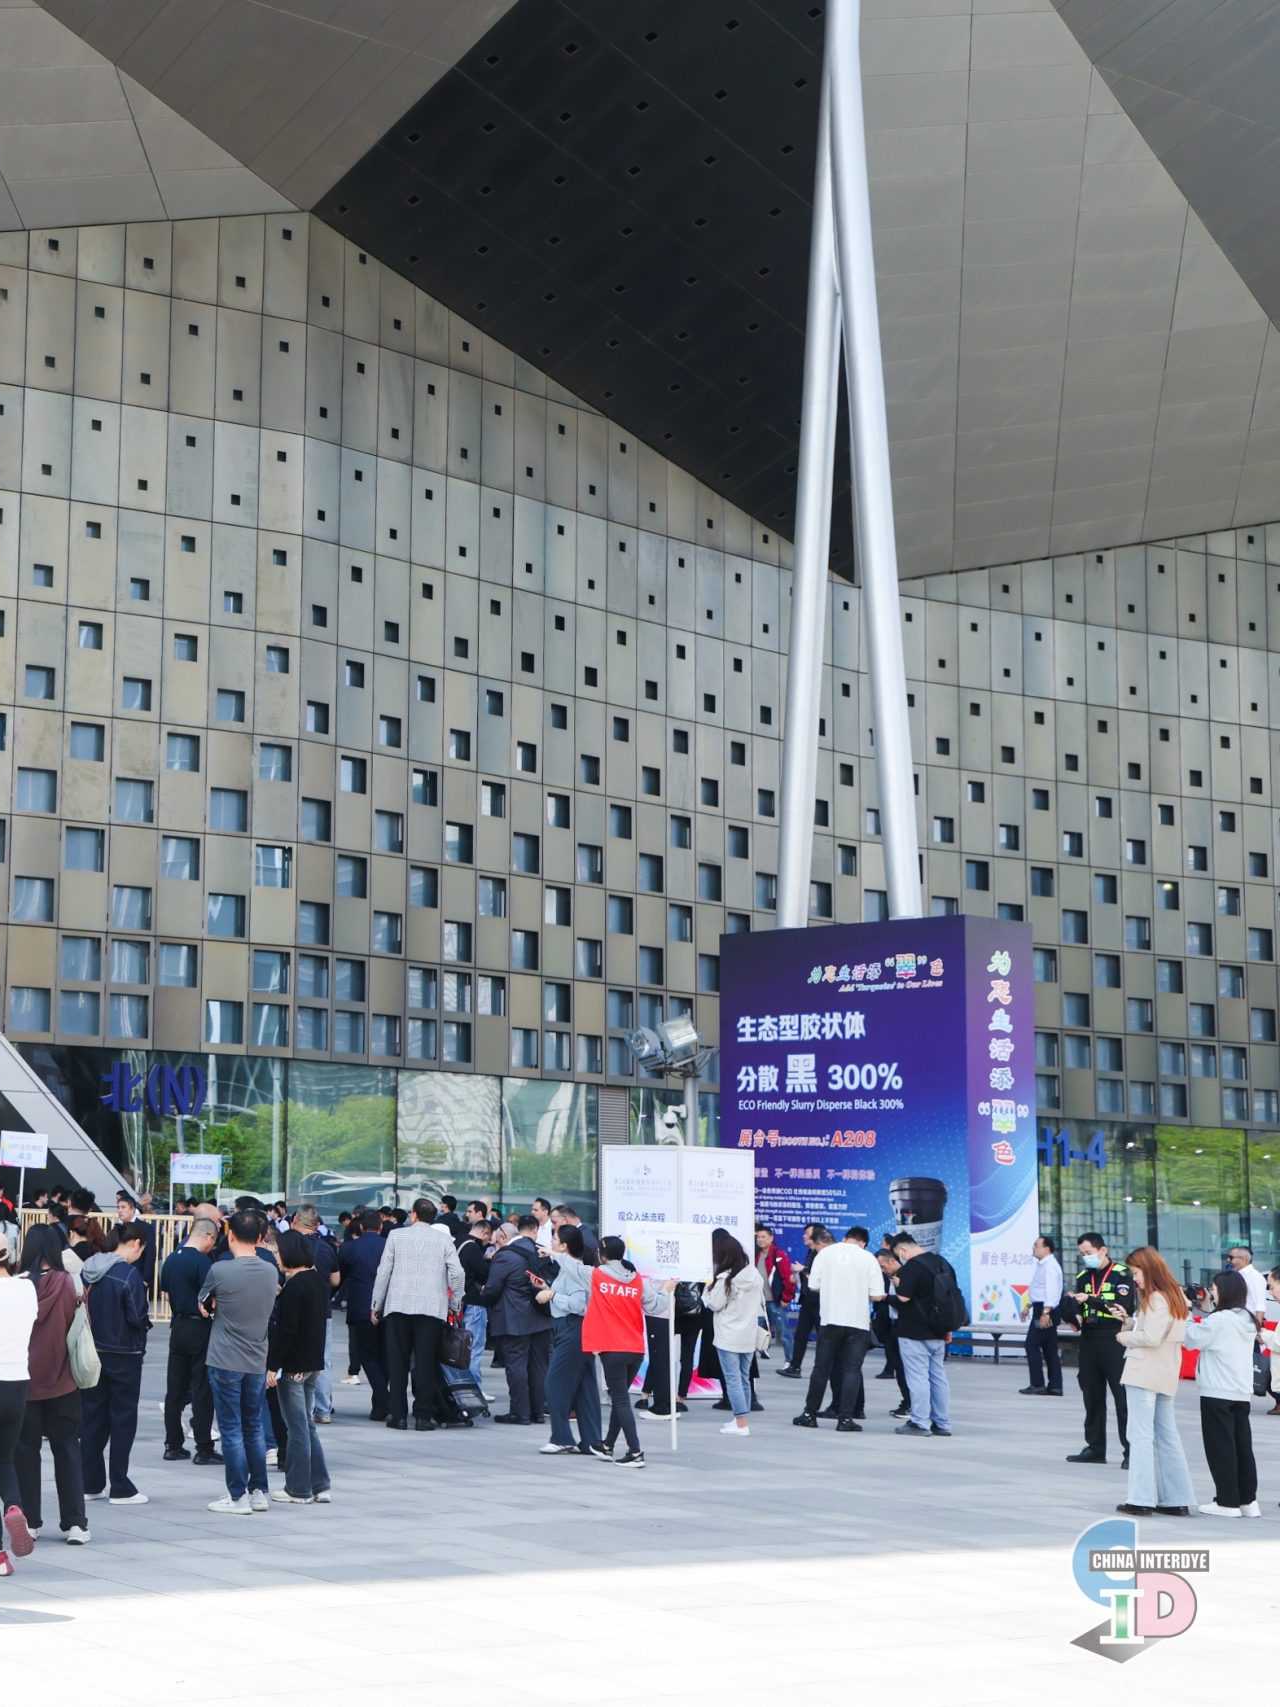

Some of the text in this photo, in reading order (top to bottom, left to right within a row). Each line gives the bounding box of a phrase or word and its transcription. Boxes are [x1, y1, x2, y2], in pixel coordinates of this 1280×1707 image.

[736, 1011, 866, 1043] 生态型胶状体
[736, 1053, 903, 1093] 分散 黑 300%
[738, 1098, 904, 1113] ECO Friendly Slurry Disperse Black 300%
[737, 1129, 780, 1147] 展台号
[830, 1130, 876, 1147] A208
[618, 1211, 666, 1223] 观众入场流程
[599, 1282, 638, 1299] STAFF
